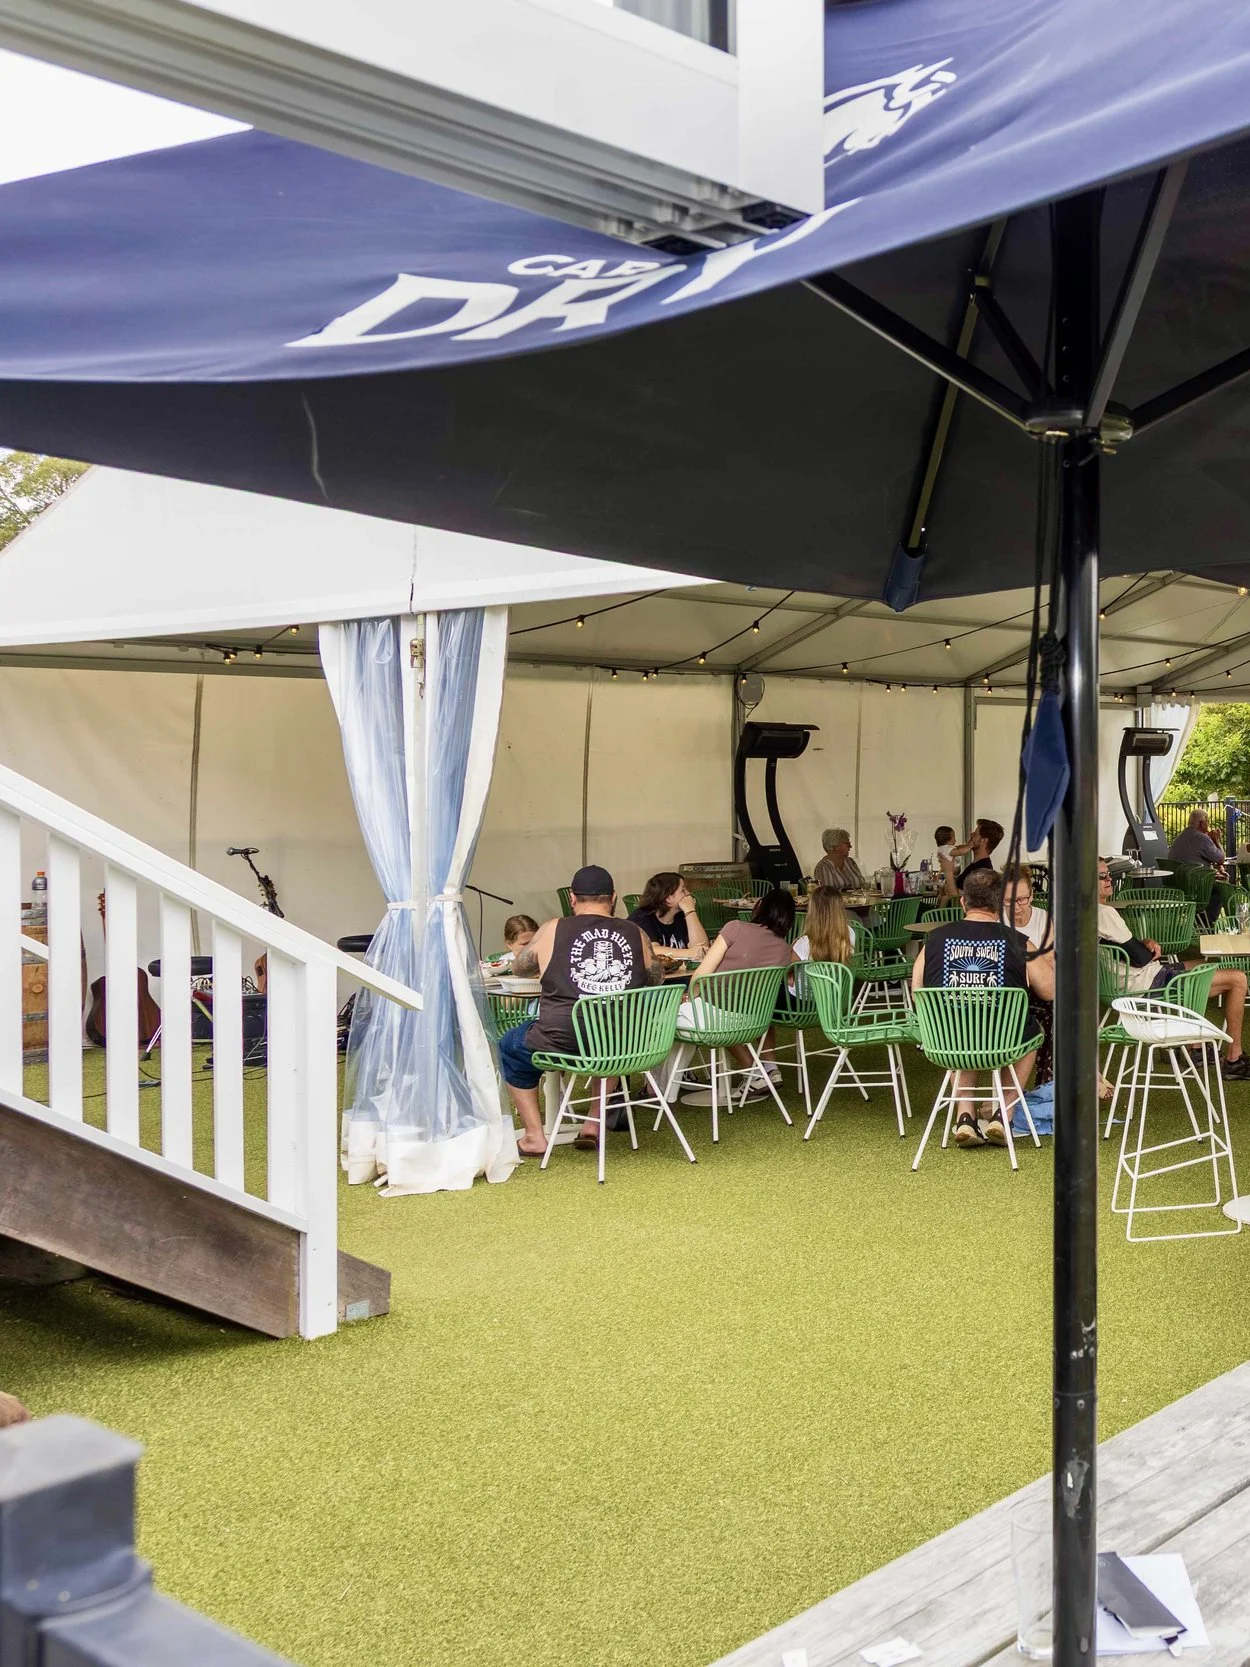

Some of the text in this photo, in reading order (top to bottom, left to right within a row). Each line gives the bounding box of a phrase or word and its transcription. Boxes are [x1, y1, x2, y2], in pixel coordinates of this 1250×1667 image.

[507, 254, 662, 278] CAR
[570, 939, 586, 964] THE
[581, 928, 609, 943] MAD
[610, 931, 633, 966] HUEYS
[949, 945, 999, 962] SOUTH SWELL
[959, 972, 987, 983] SURF
